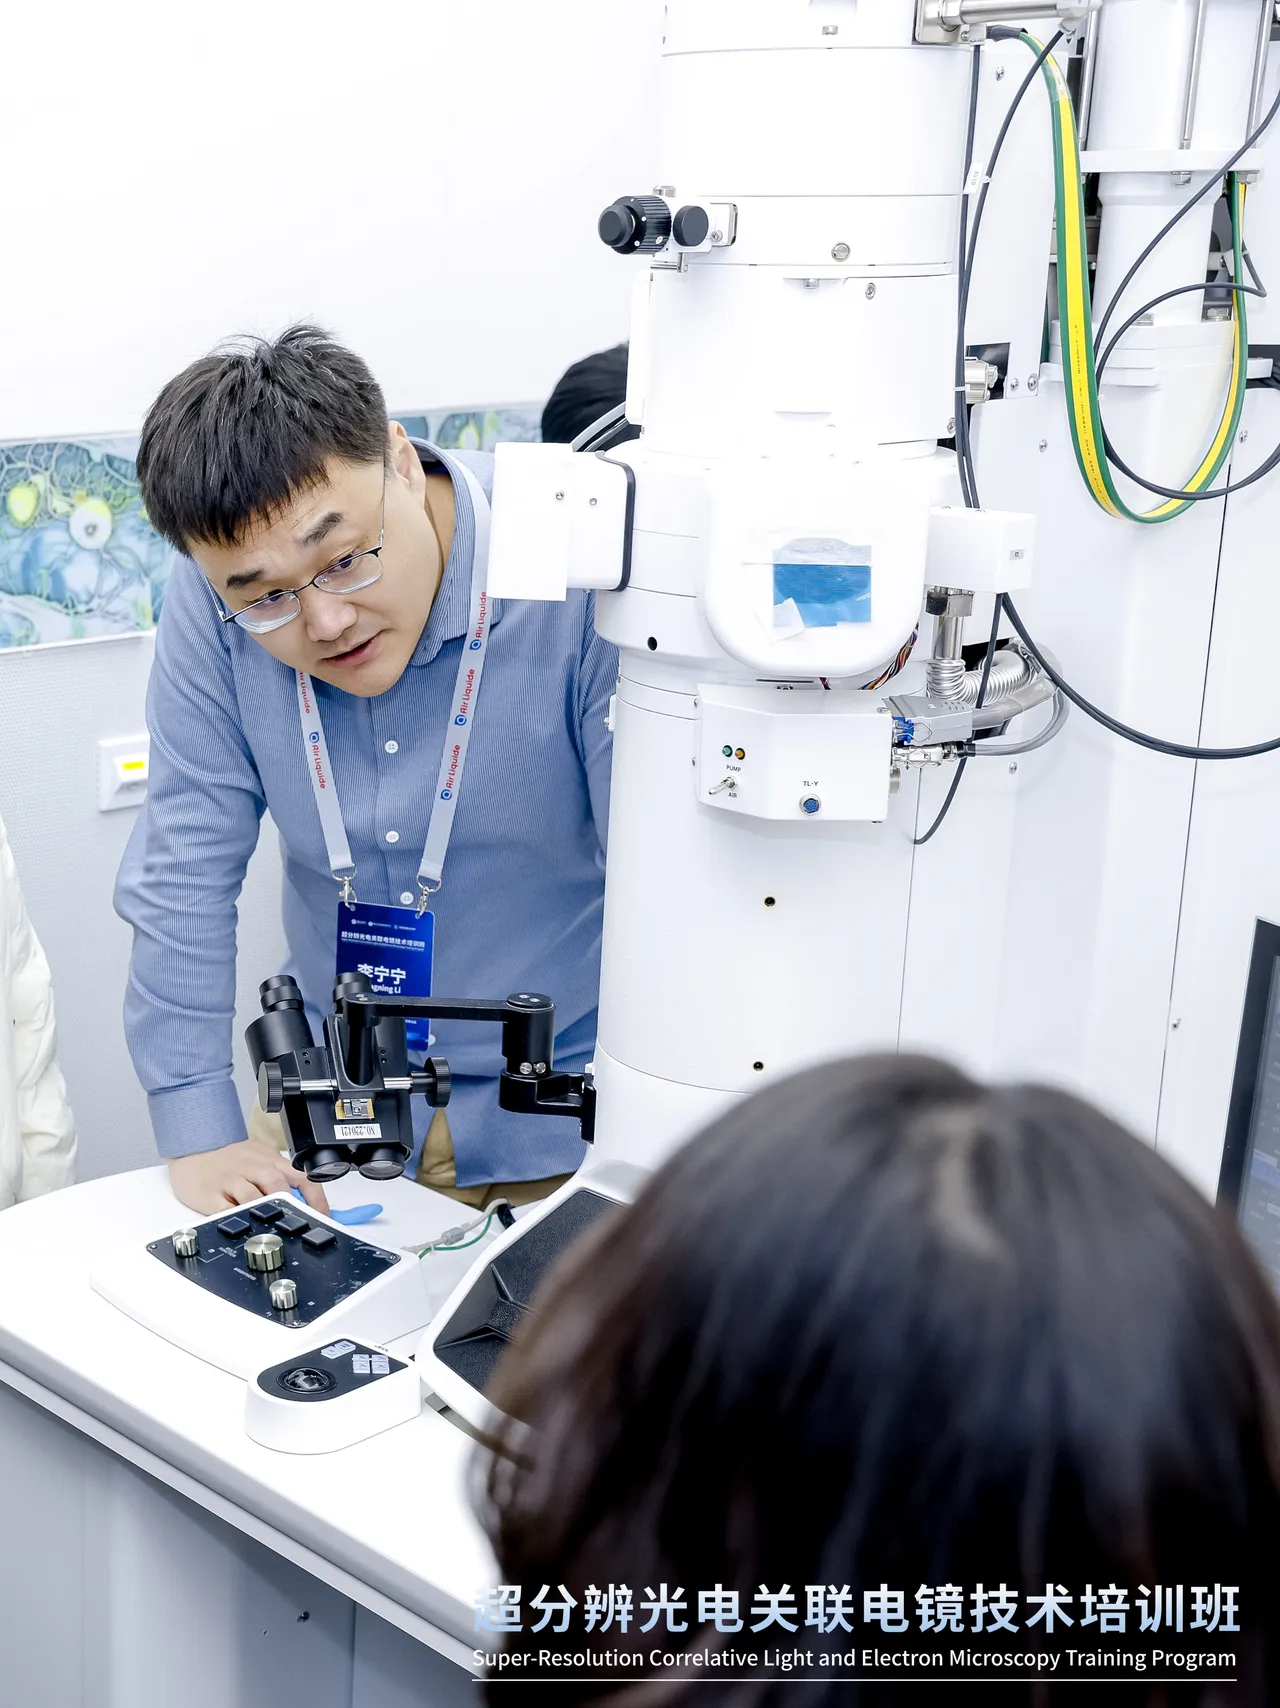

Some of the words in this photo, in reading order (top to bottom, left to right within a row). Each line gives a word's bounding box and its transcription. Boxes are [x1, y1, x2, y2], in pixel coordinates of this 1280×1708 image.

[477, 591, 487, 625] Liquide
[301, 682, 311, 714] Liquide
[462, 668, 475, 700] Liquide
[460, 700, 468, 714] Air
[312, 744, 320, 757] Air
[448, 744, 461, 776] Liquide
[314, 757, 326, 789] Liquide
[726, 764, 741, 772] PUMP
